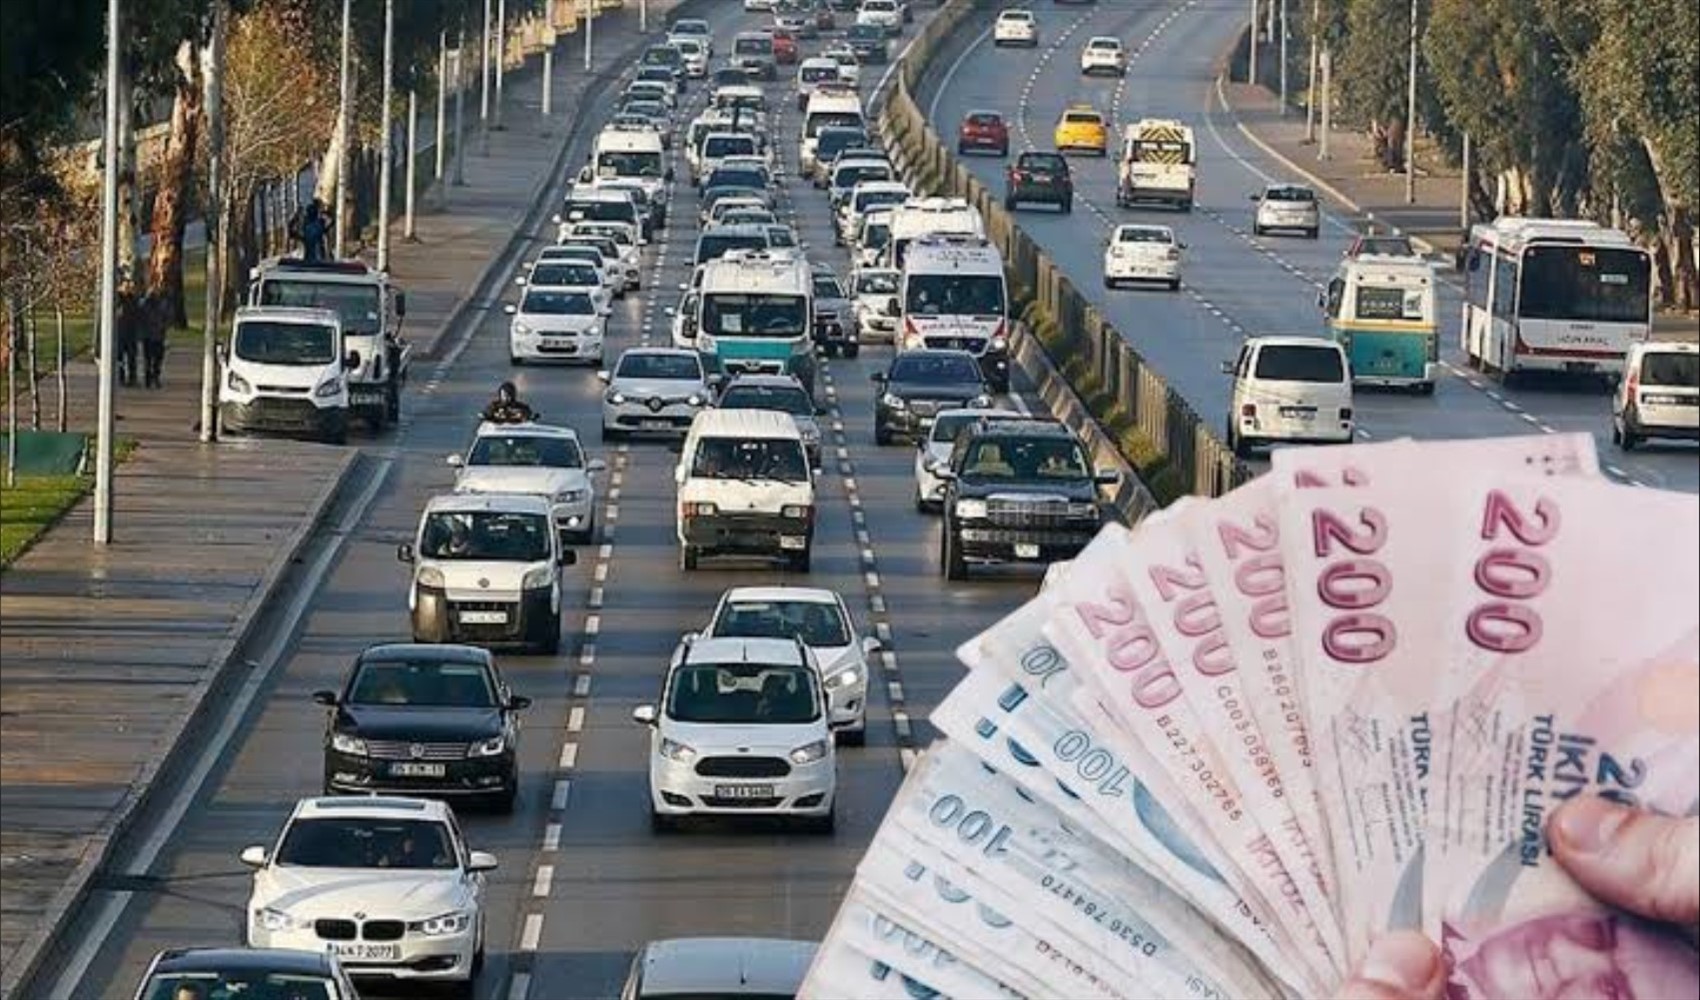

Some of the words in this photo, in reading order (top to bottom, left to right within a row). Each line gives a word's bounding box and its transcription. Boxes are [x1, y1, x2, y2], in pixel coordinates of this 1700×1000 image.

[1148, 551, 1237, 677] 200
[1217, 514, 1293, 640] 200
[1311, 506, 1398, 664] 200
[1464, 488, 1562, 655] 200
[1074, 583, 1184, 710] 200
[1053, 730, 1130, 798] 100
[1527, 714, 1555, 781] TÜRK
[929, 794, 1013, 858] 100
[1520, 788, 1546, 868] LİRASI
